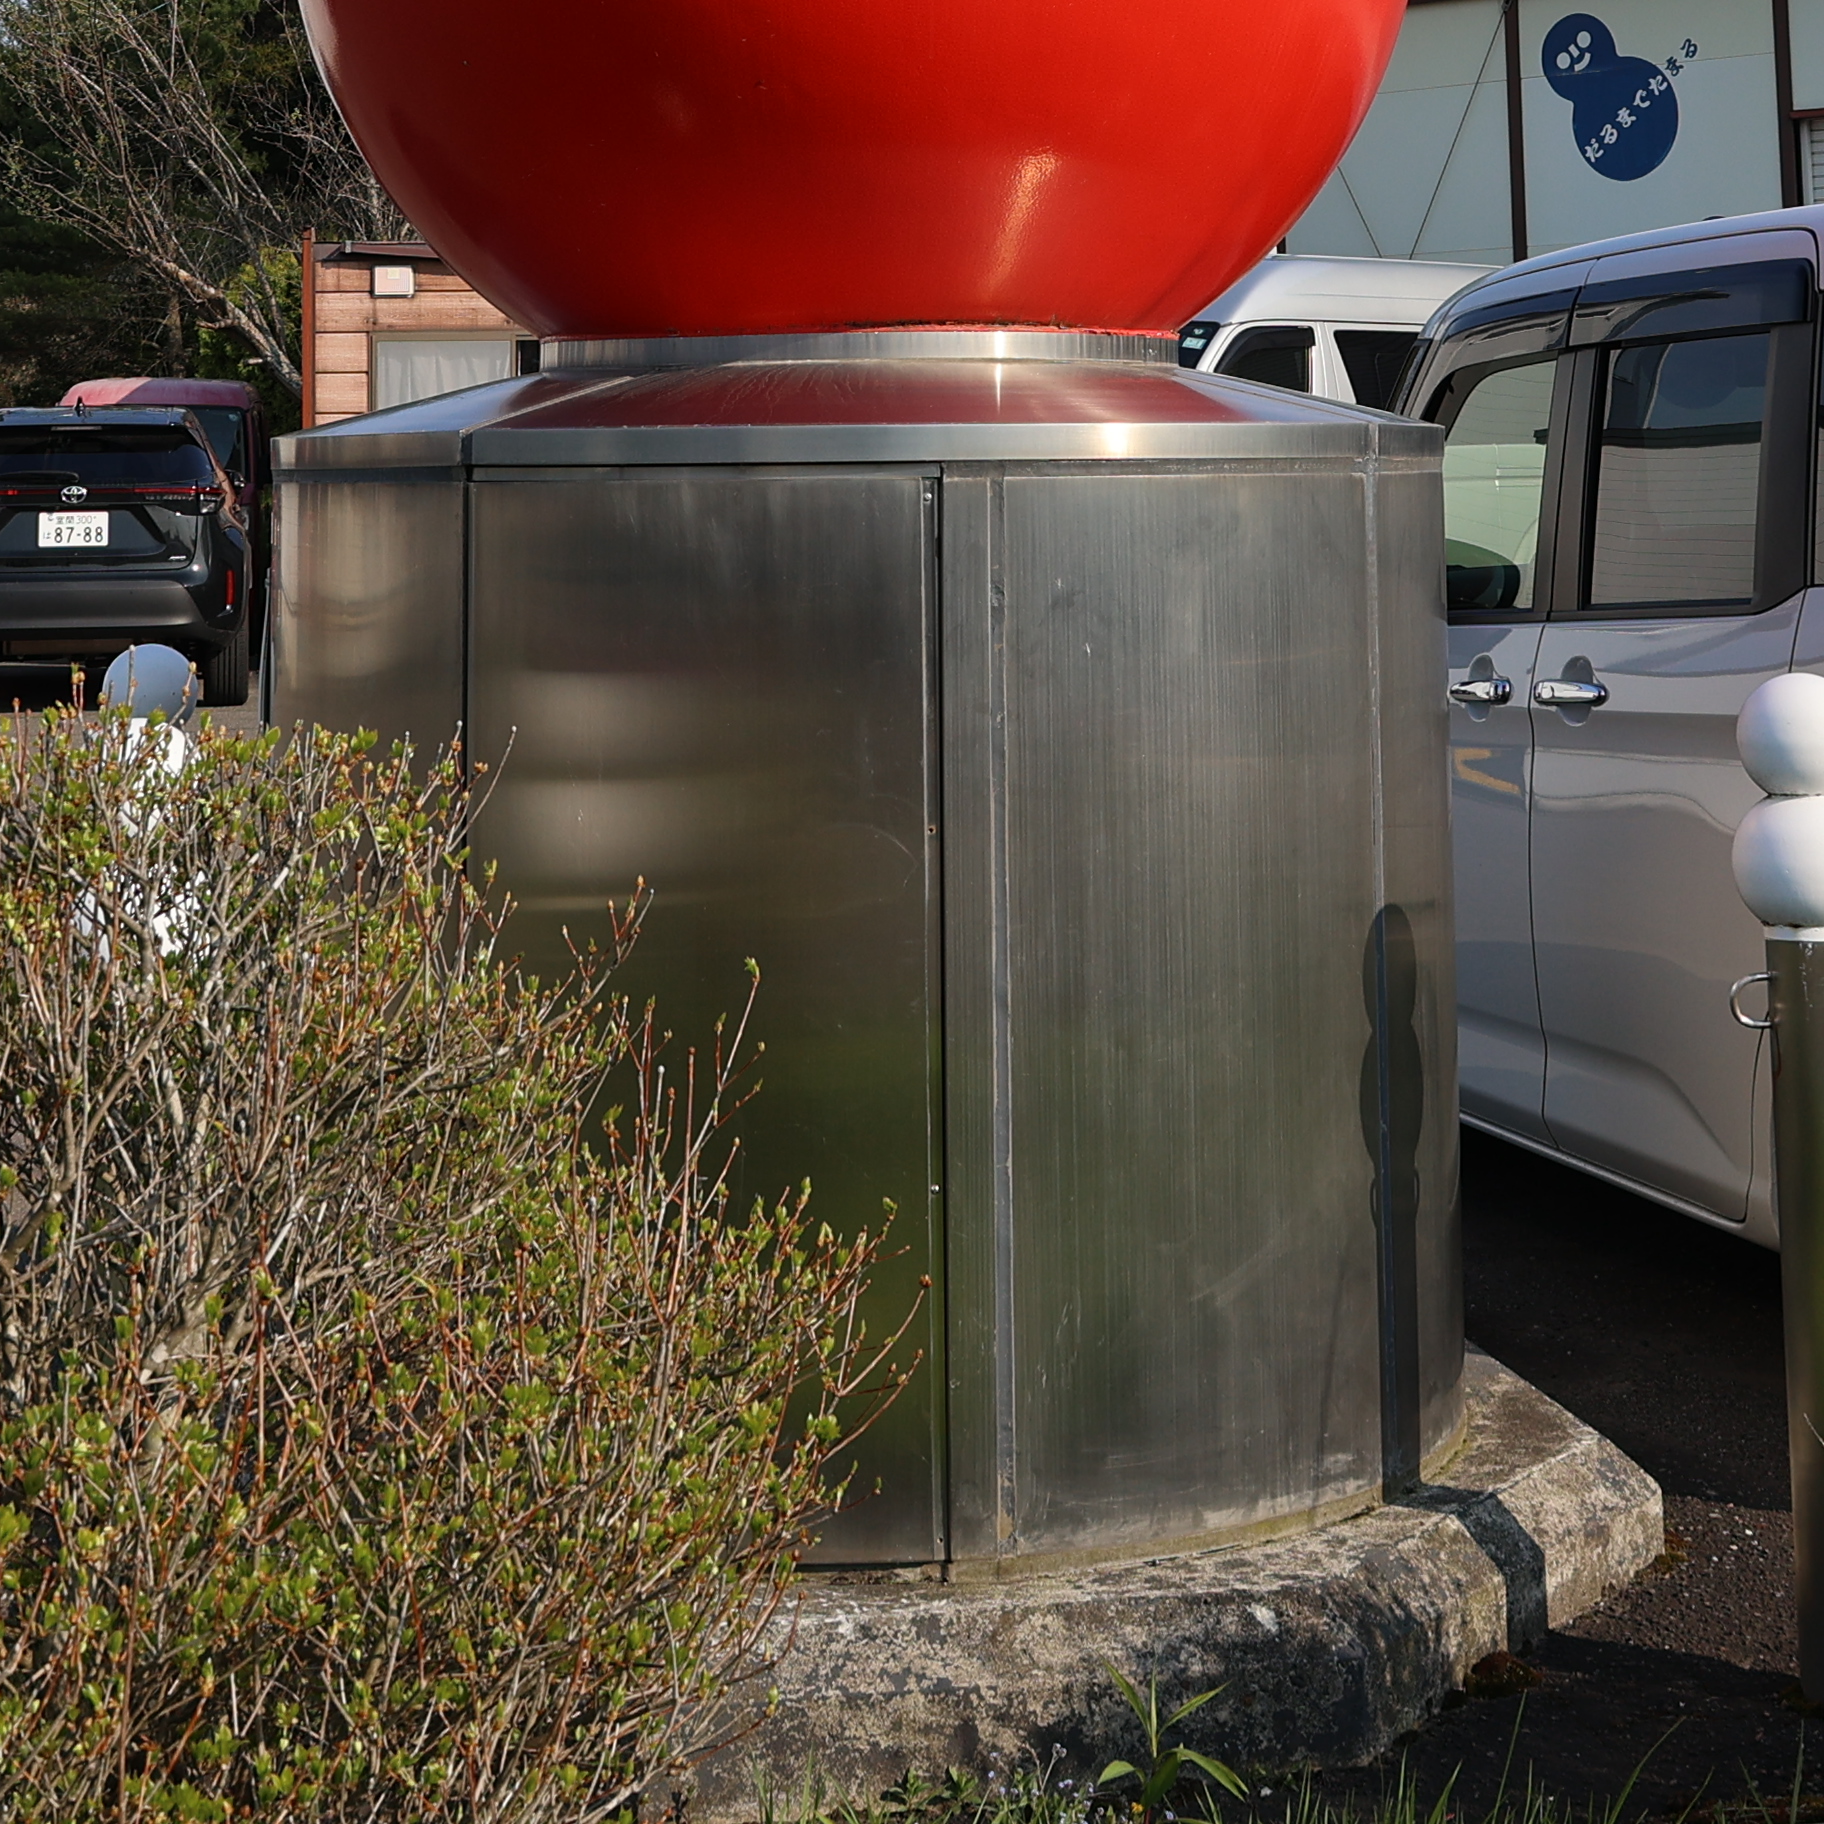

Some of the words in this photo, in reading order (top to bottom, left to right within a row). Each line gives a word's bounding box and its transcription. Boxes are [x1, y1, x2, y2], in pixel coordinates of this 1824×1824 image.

[1585, 38, 1698, 162] だるまでたまる
[54, 526, 103, 543] 87-88
